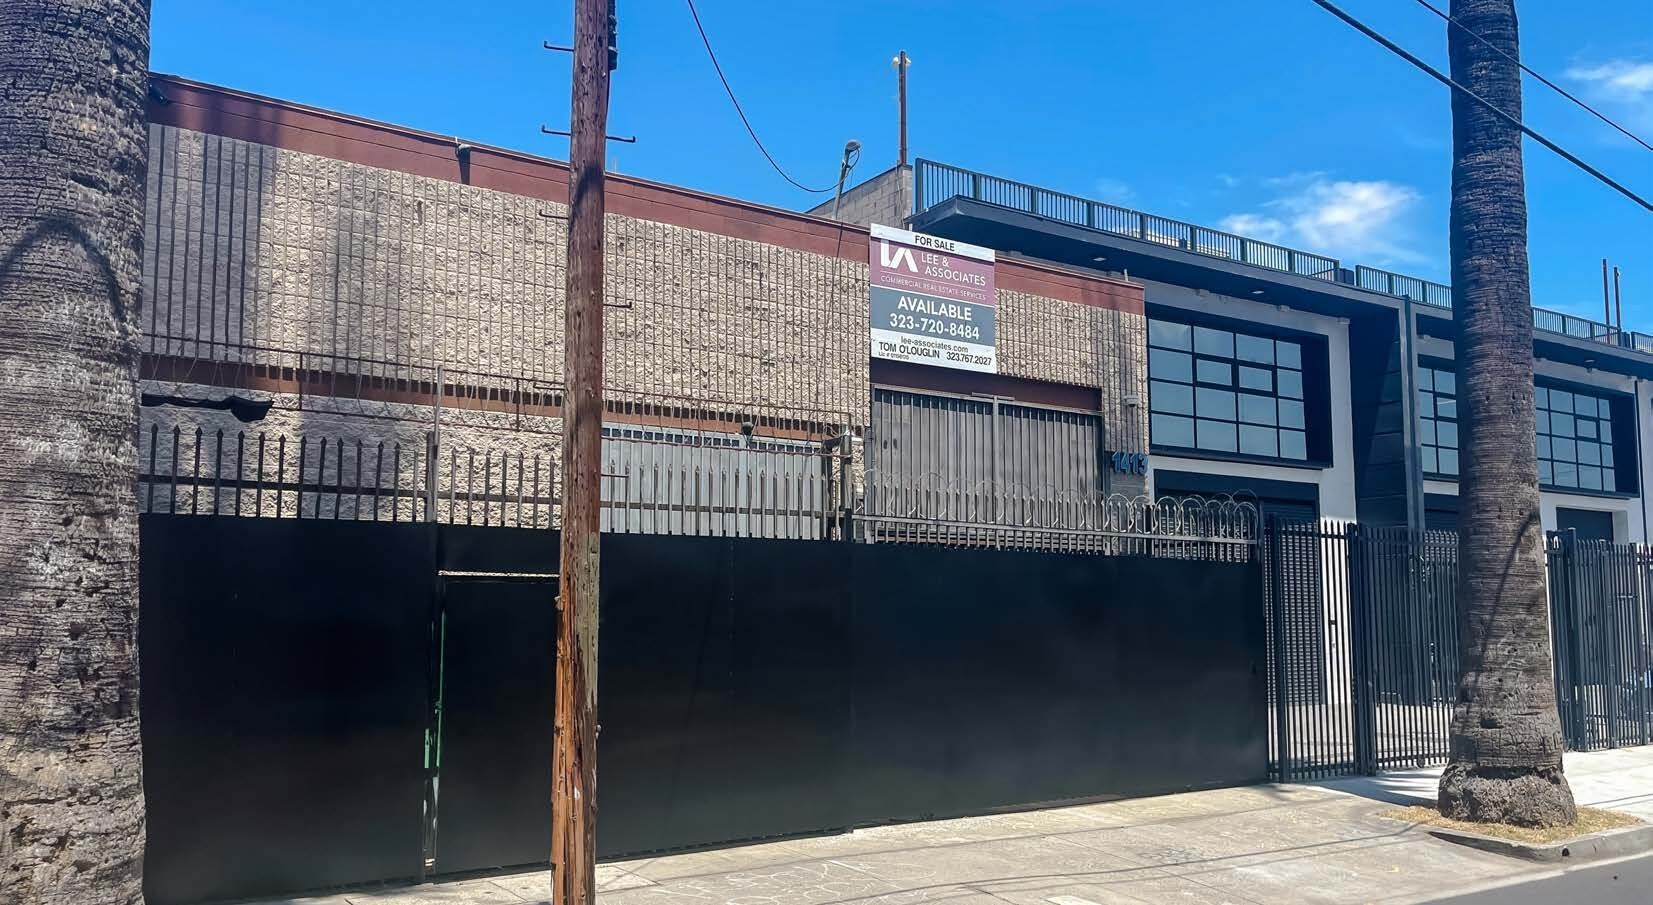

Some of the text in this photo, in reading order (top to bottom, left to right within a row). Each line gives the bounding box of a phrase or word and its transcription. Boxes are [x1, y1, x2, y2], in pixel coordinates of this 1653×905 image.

[915, 235, 955, 252] FOR SALE
[921, 252, 950, 267] LEE &
[880, 275, 986, 301] COMMERCIAL REAL ESTATE SERVICES
[925, 266, 986, 286] ASSOCIATES
[898, 296, 973, 321] AVAILABLE
[889, 313, 980, 340] 323-720-8484
[879, 341, 897, 353] TOM
[899, 344, 940, 359] O'LOUGLIN
[946, 351, 992, 366] 323.767.2027
[901, 336, 968, 353] lee-associates.com
[1112, 450, 1148, 475] 1413
